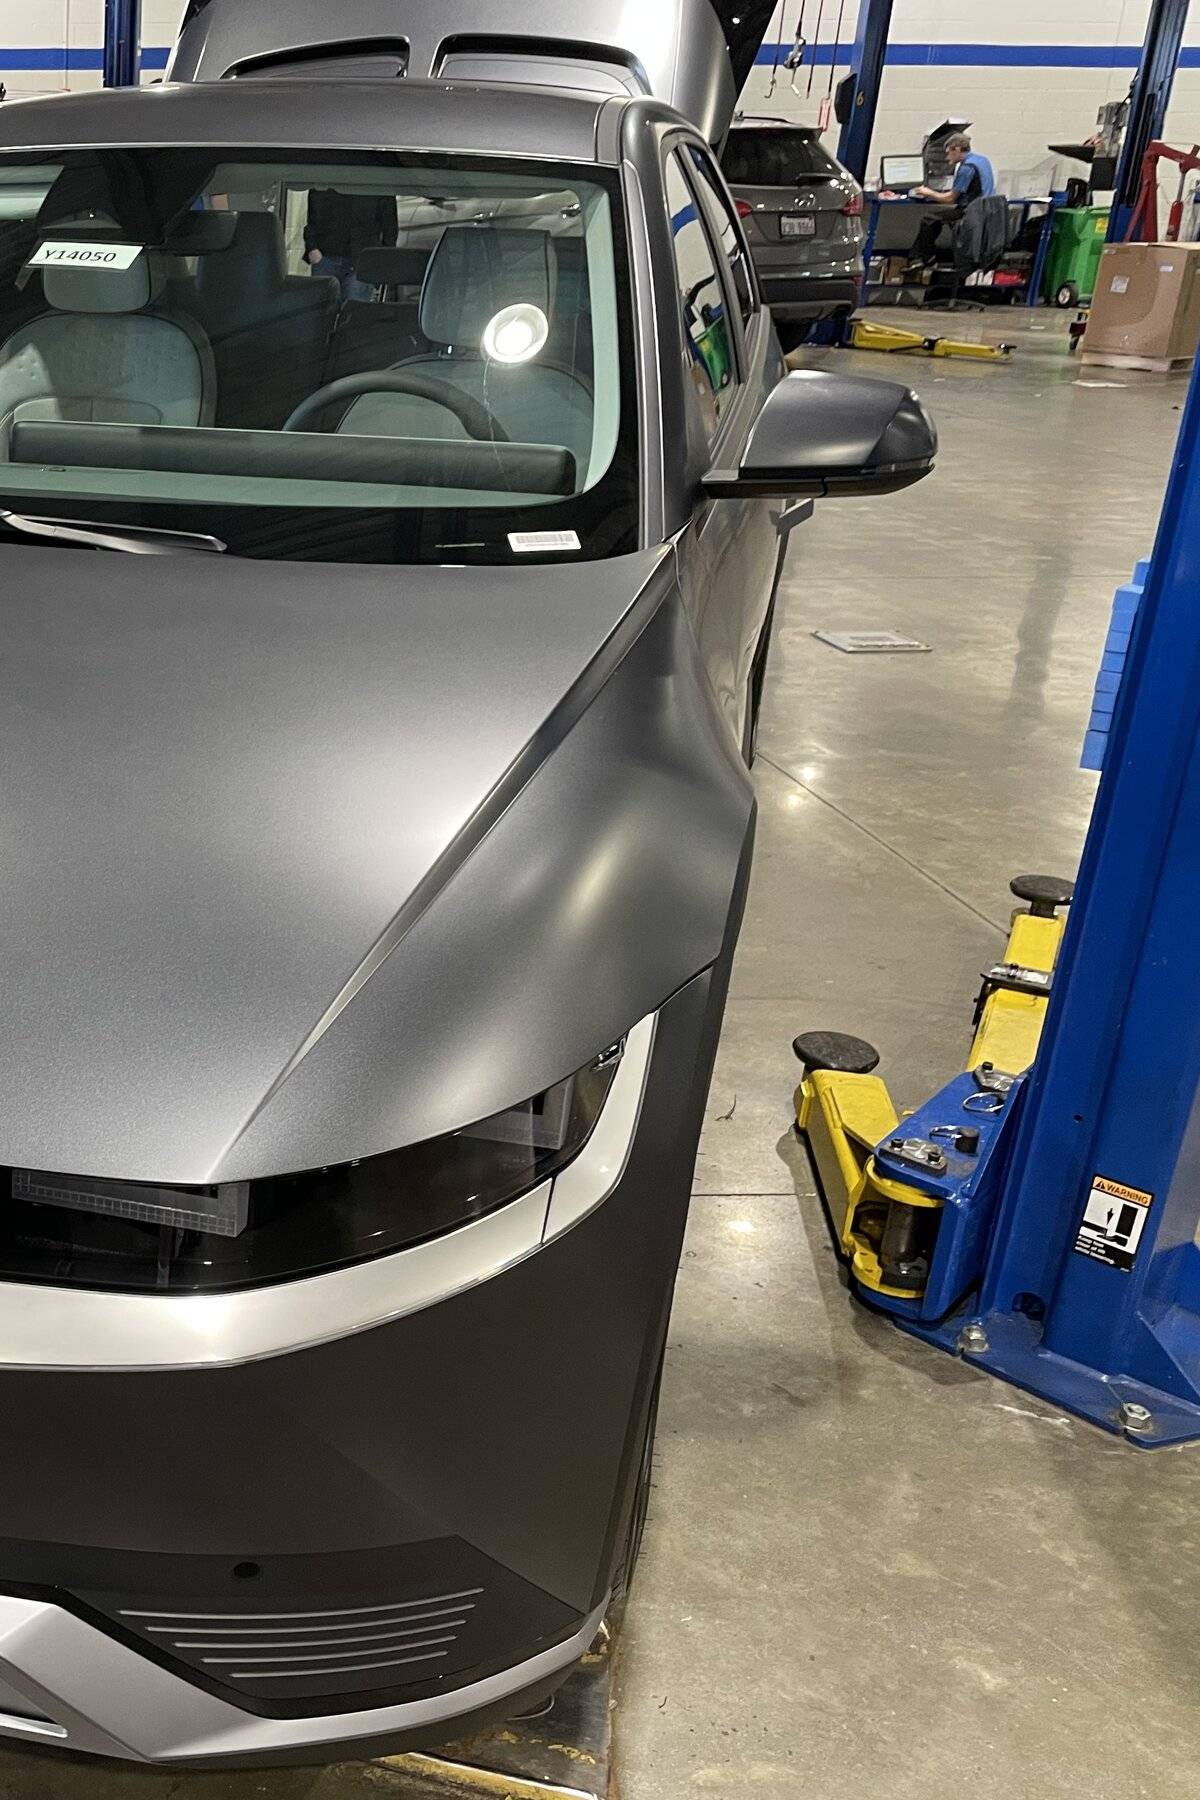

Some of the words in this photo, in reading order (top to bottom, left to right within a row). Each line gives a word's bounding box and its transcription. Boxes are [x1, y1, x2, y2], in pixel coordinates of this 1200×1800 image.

[856, 91, 864, 106] 6
[44, 249, 117, 263] Y14050
[1106, 1183, 1149, 1205] WARNING
